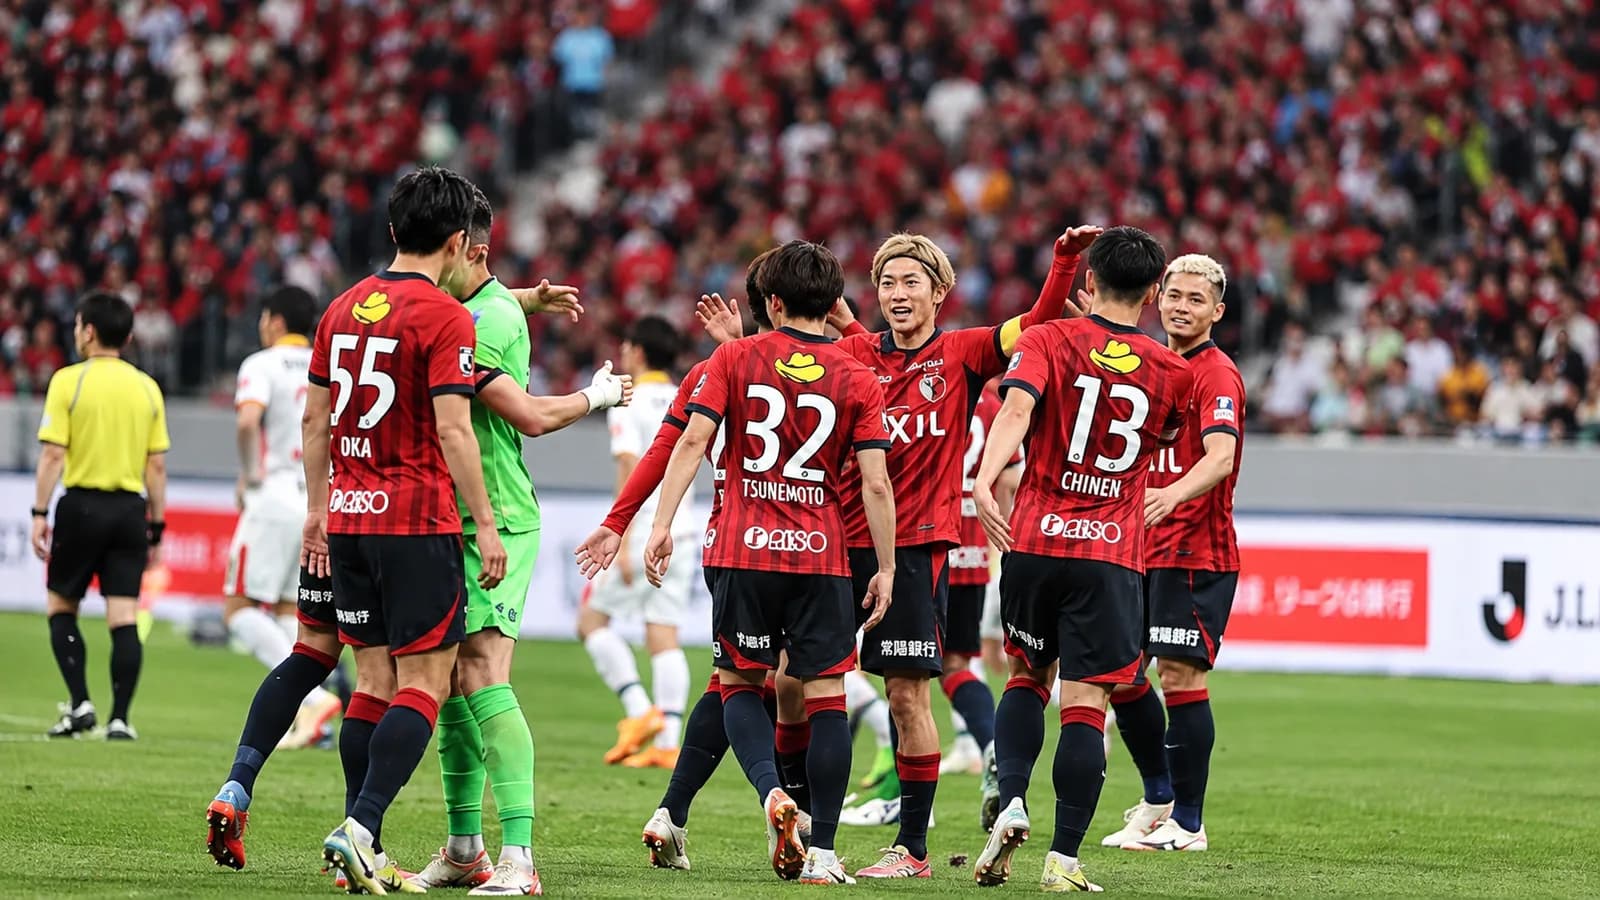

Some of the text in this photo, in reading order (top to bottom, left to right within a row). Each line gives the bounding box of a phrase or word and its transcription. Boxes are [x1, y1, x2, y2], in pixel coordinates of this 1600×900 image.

[330, 334, 399, 429] 55
[743, 384, 837, 483] 32
[1067, 374, 1150, 473] 13
[341, 436, 372, 458] OKA
[742, 479, 825, 505] TSUNEMOTO
[1061, 471, 1122, 498] CHINEN
[1543, 585, 1600, 630] J.L
